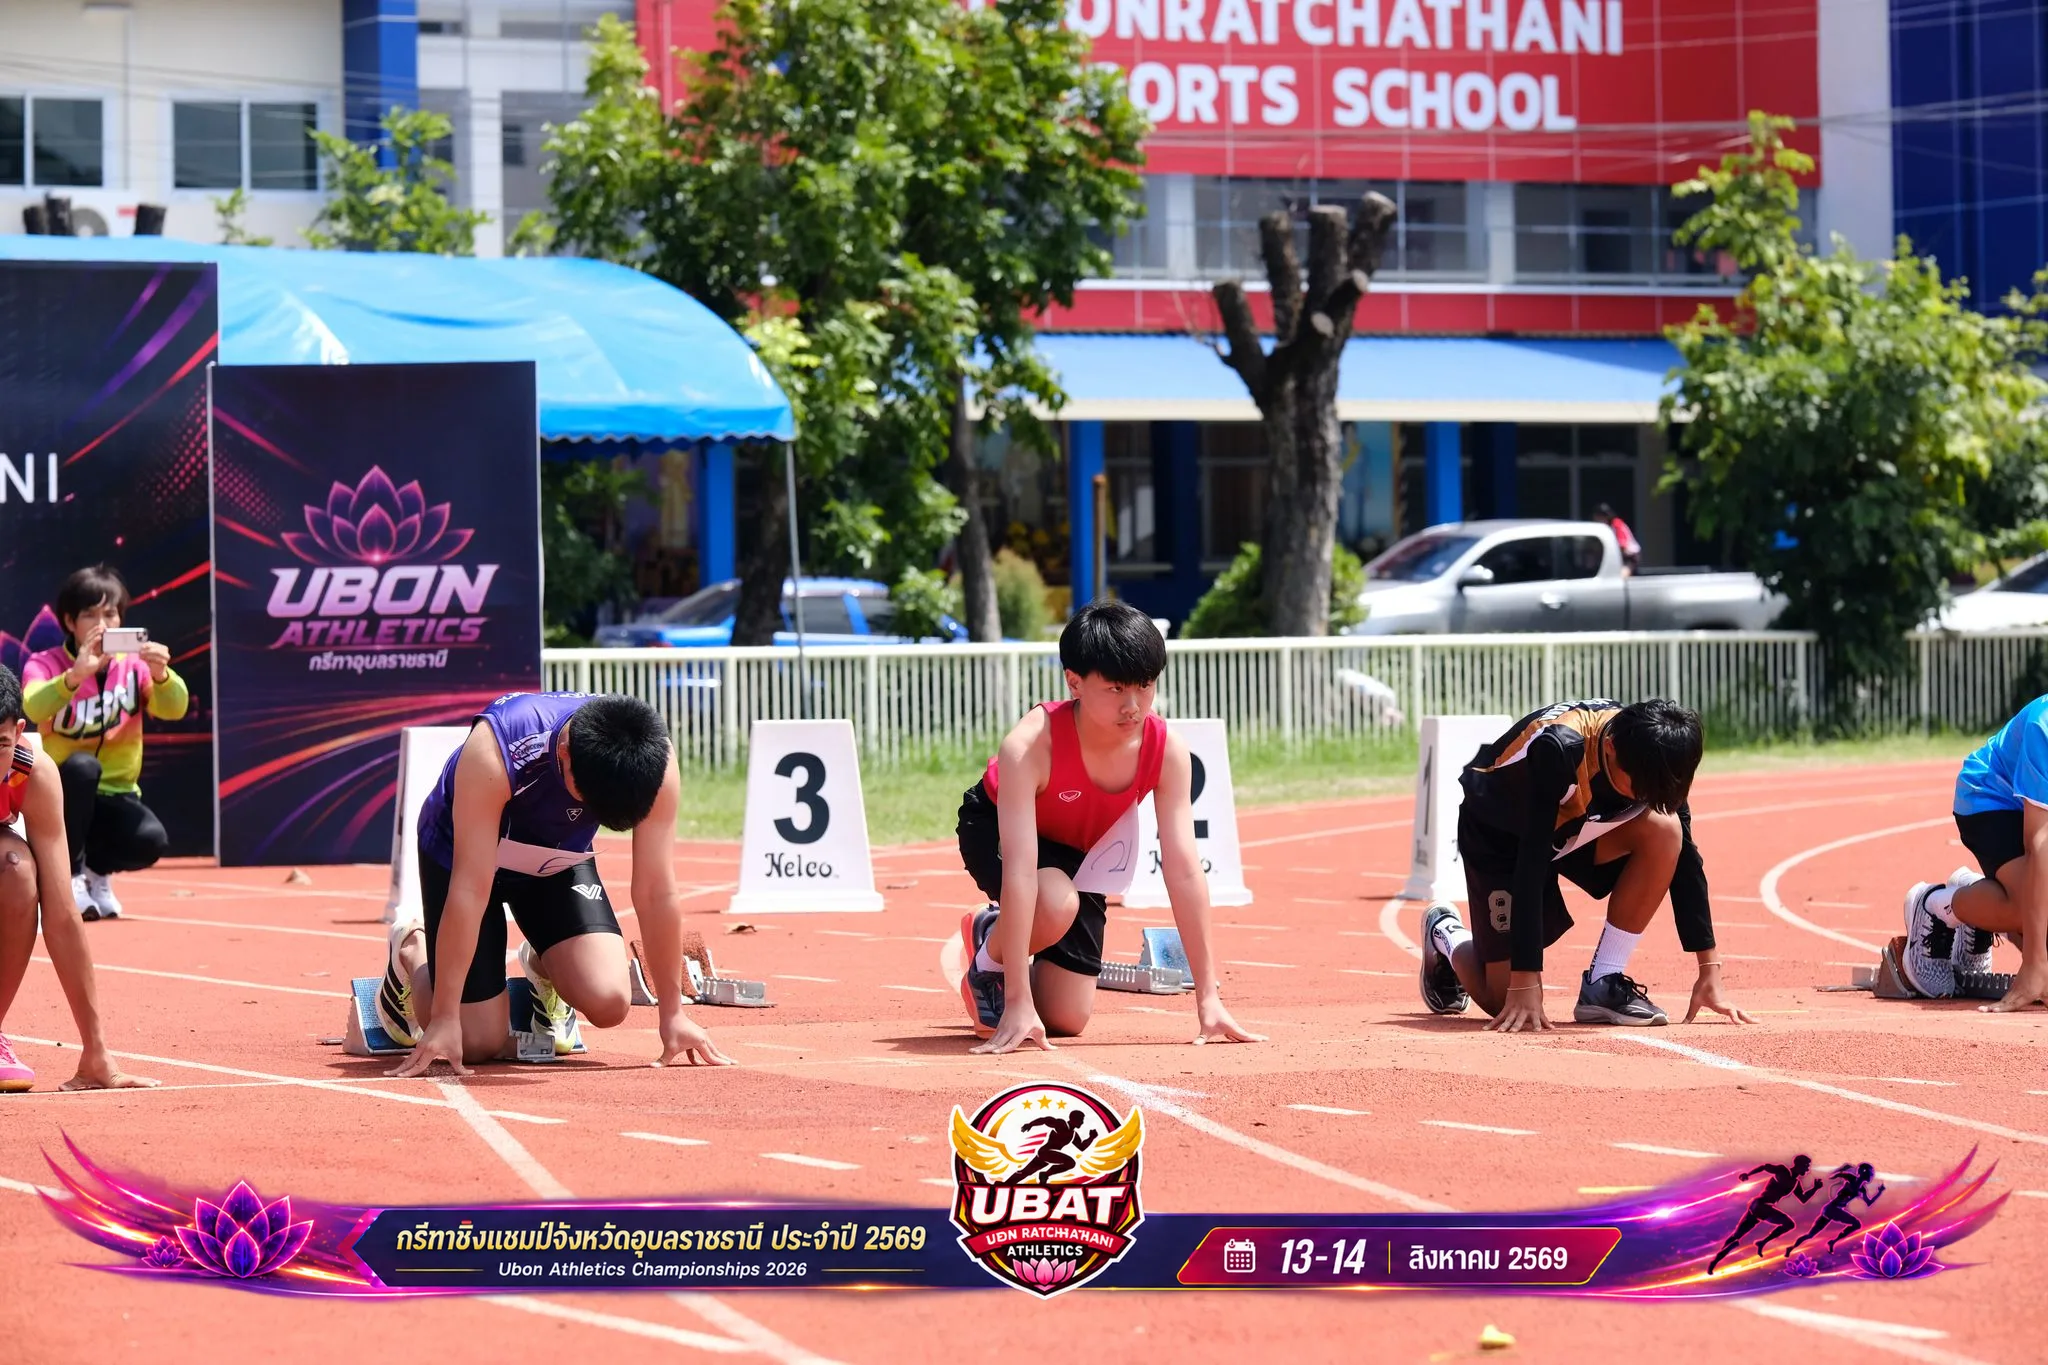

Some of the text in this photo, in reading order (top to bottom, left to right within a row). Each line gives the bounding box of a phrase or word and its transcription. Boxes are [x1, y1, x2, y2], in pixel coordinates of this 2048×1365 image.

[967, 0, 1624, 56] ONRATCHATHANI
[1090, 61, 1578, 132] ORTS SCHOOL
[266, 564, 500, 618] UBON
[269, 616, 491, 650] ATHLETICS
[773, 752, 830, 845] 3
[764, 852, 833, 879] Nelco
